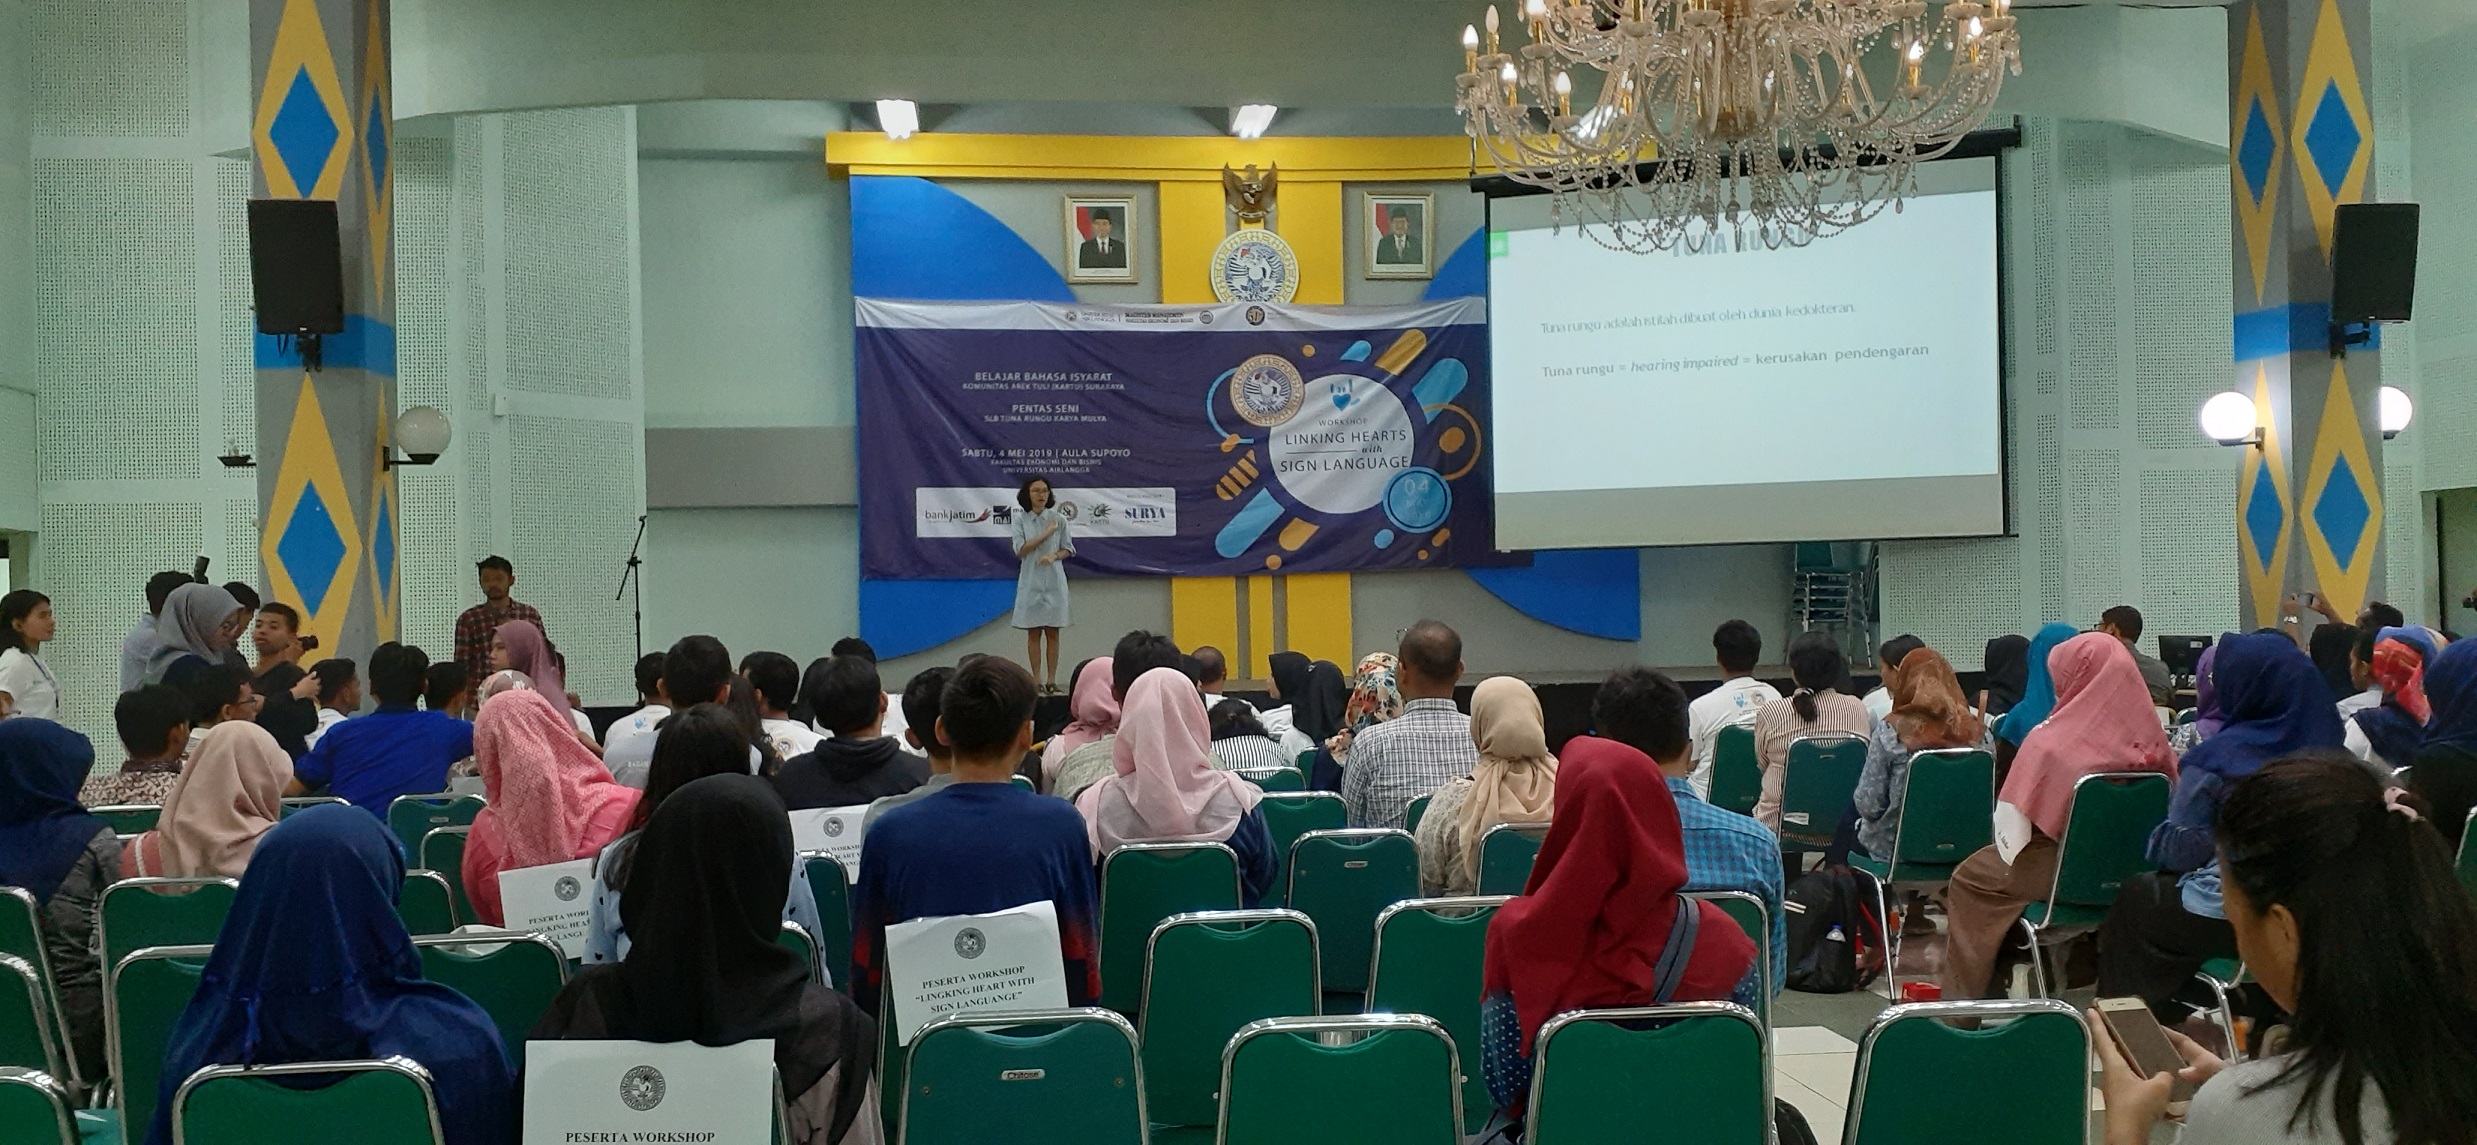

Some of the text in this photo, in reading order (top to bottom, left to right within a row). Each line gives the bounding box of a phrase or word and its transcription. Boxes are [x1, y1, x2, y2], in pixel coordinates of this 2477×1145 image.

[1541, 322, 1566, 334] Tuna
[1567, 321, 1601, 333] rungu
[1604, 316, 1642, 329] adalah
[1679, 311, 1716, 324] dibuat
[1719, 309, 1746, 322] oleh
[1749, 308, 1782, 319] dunia
[1541, 365, 1573, 378] Tuna
[1576, 363, 1615, 376] rungu
[1631, 358, 1681, 373] hearing
[1683, 355, 1739, 371] impaired
[1756, 351, 1828, 365] kerusakan
[1834, 344, 1930, 363] pendengaran
[974, 372, 1113, 382] BELAJAR BAHASA ISYARAT
[1085, 383, 1125, 391] SURABAYA
[1012, 404, 1080, 413] PENTAS SENI
[1319, 417, 1369, 427] WORKSHOP
[1285, 429, 1407, 445] LINKING HEARTS
[961, 448, 997, 459] SABTU,
[998, 449, 1005, 458] 4
[1007, 449, 1026, 458] MEI
[1029, 449, 1053, 458] 2019
[1062, 449, 1088, 458] AULA
[1091, 449, 1131, 458] SUPOYO
[1361, 445, 1383, 454] with
[1280, 455, 1409, 473] SIGN LANGUAGE
[1404, 478, 1431, 496] 04
[1124, 507, 1166, 519] SURYA
[528, 913, 565, 925] PESERTA
[922, 965, 1026, 990] PESERTA WORKSHOP
[972, 981, 1006, 994] HEART
[1007, 976, 1036, 988] WITH
[931, 1003, 955, 1014] SIGN
[1007, 1071, 1040, 1080] Chitose
[565, 1132, 715, 1143] PESERTA WORKSHOP
